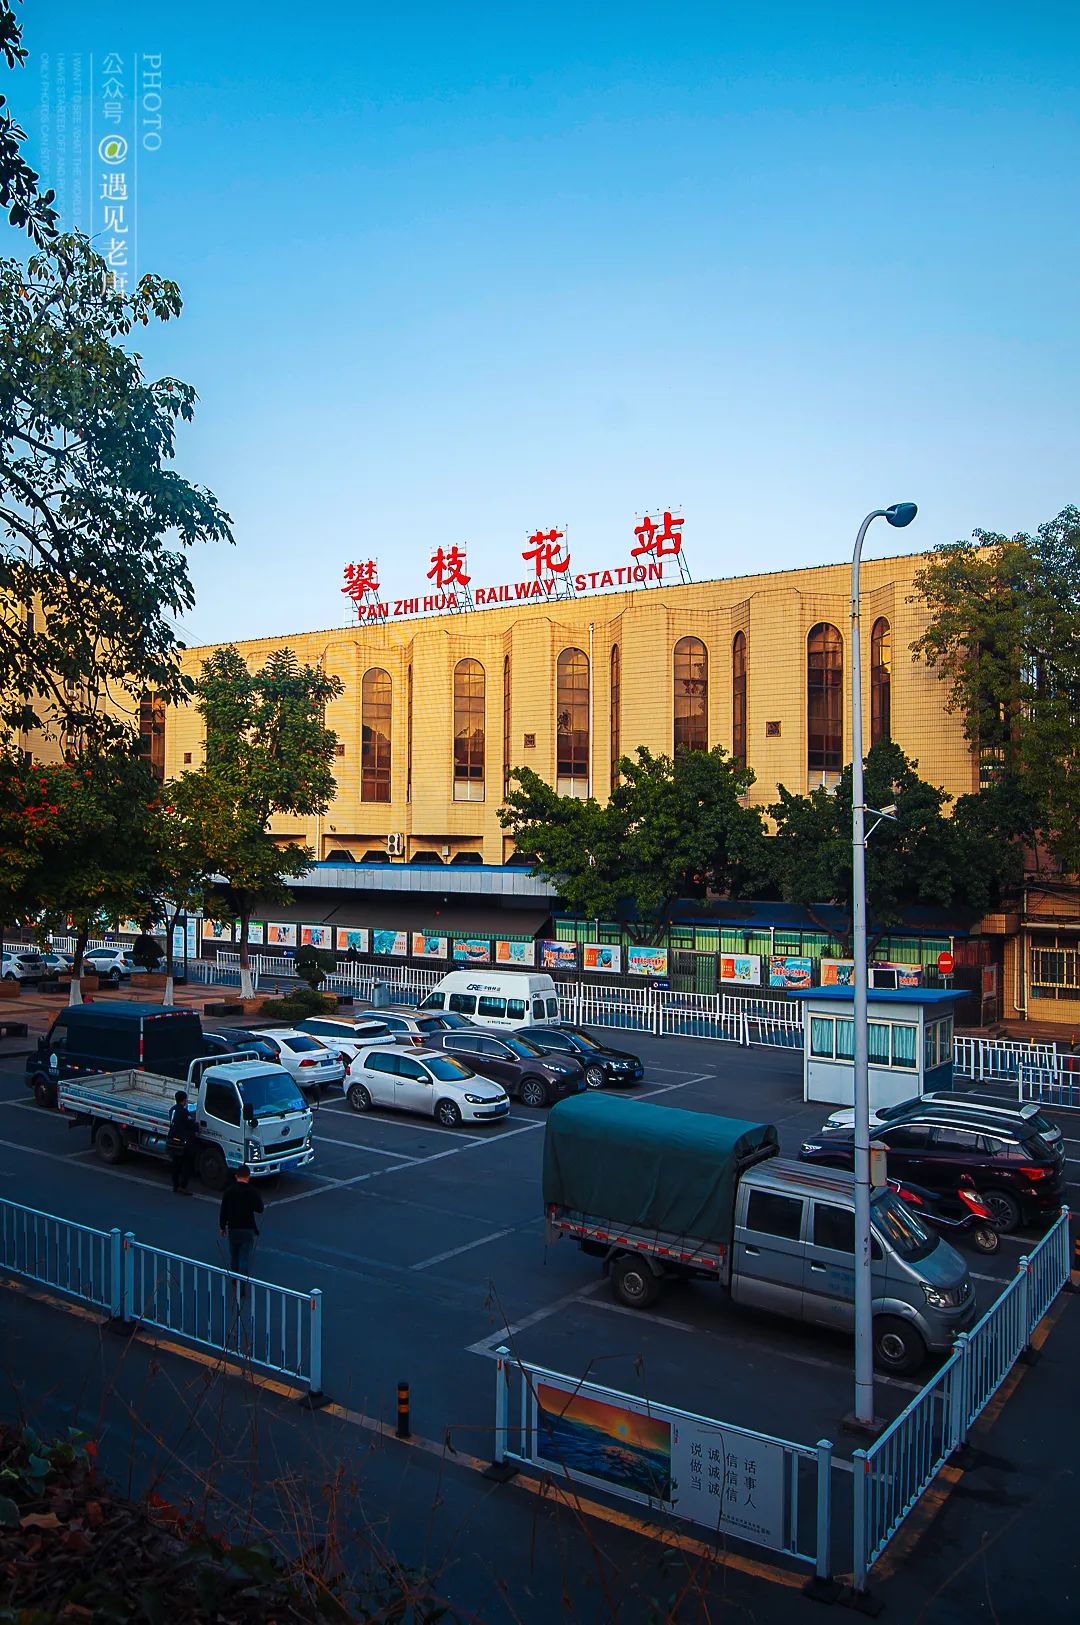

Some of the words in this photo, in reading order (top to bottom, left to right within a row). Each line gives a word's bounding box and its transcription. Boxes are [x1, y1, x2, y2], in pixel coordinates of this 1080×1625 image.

[341, 512, 684, 601] 攀枝花站
[358, 602, 389, 619] PAN
[394, 599, 420, 616] ZHI
[424, 592, 458, 611] HUA
[476, 579, 556, 604] RAILWAY
[575, 562, 664, 591] STATION
[690, 1442, 757, 1475] 说诚信话
[690, 1459, 757, 1491] 做诚信事
[690, 1476, 757, 1509] 当诚信人
